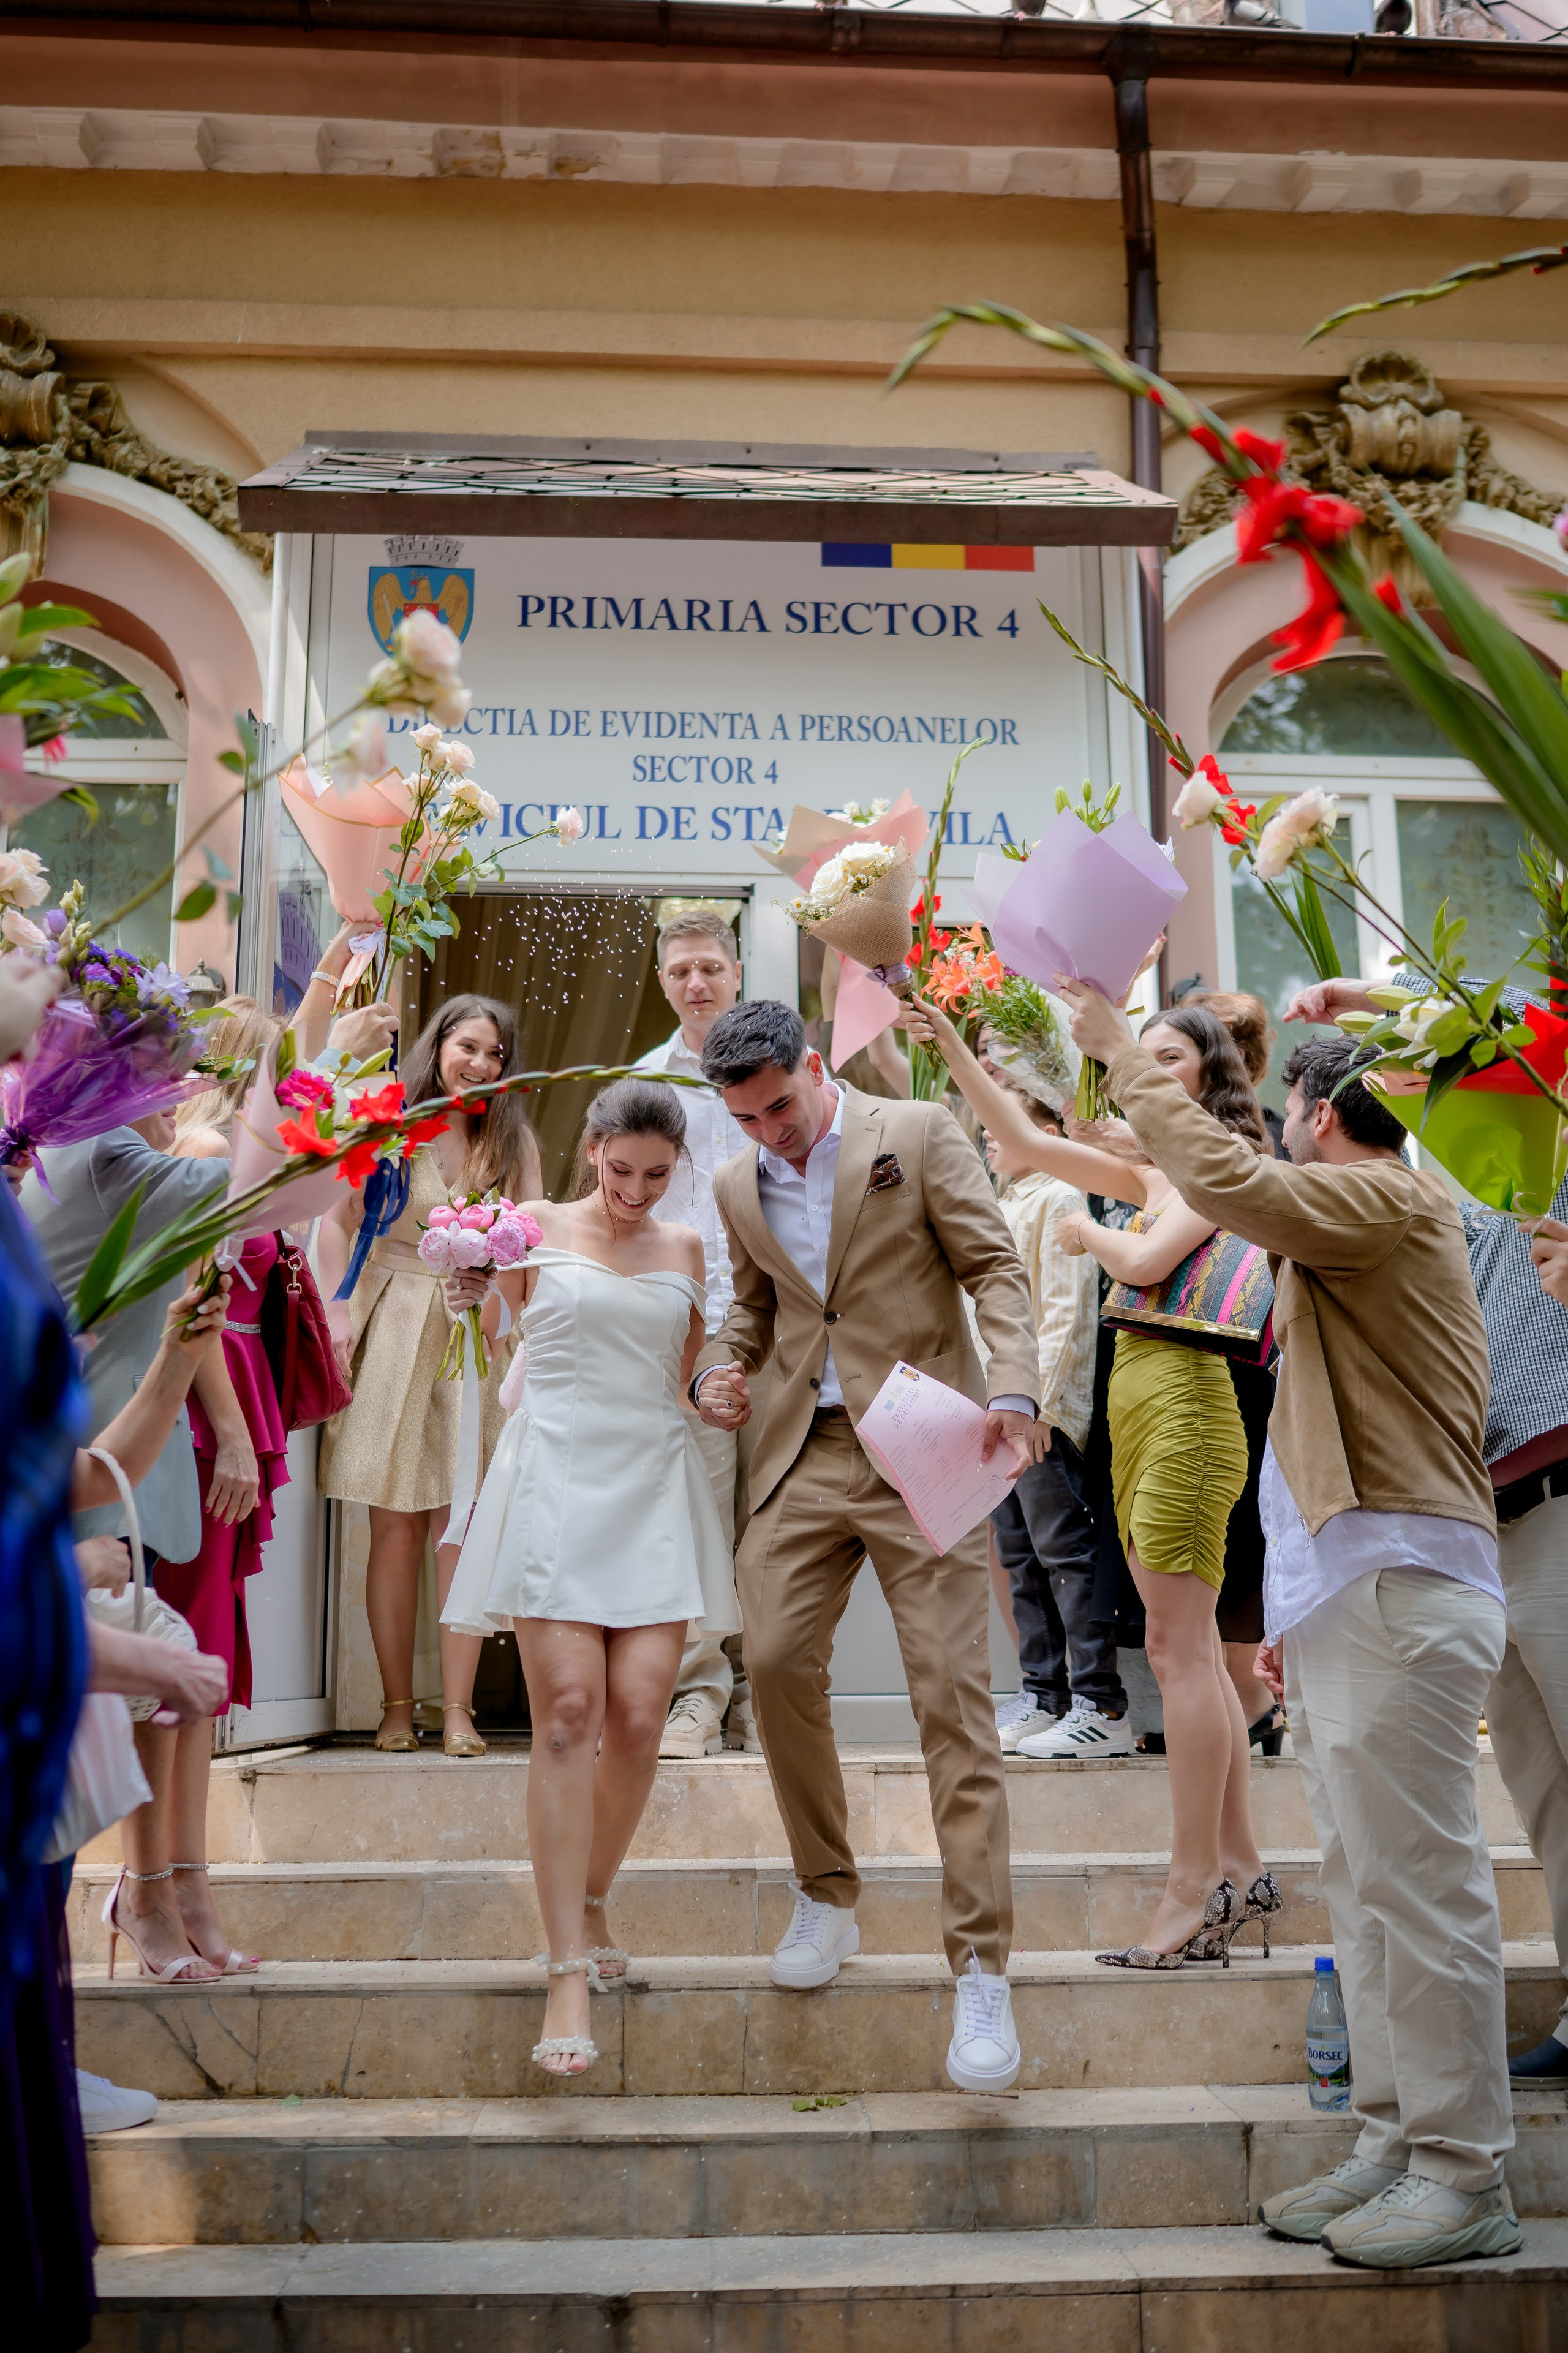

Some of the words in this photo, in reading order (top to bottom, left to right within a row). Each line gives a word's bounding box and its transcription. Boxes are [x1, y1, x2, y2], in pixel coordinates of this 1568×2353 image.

[516, 595, 772, 633] PRIMARIA
[785, 600, 984, 638] SECTOR
[997, 608, 1020, 638] 4
[548, 709, 592, 737] DE
[599, 710, 761, 740] EVIDENTA
[769, 713, 792, 741] A
[799, 714, 1020, 746] PERSOANELOR
[633, 755, 756, 784] SECTOR
[764, 759, 779, 784] 4
[635, 806, 698, 840] DE
[892, 1387, 914, 1421] CERTIFICAT
[894, 1419, 902, 1429] DE
[1308, 2047, 1343, 2061] BORSEC
